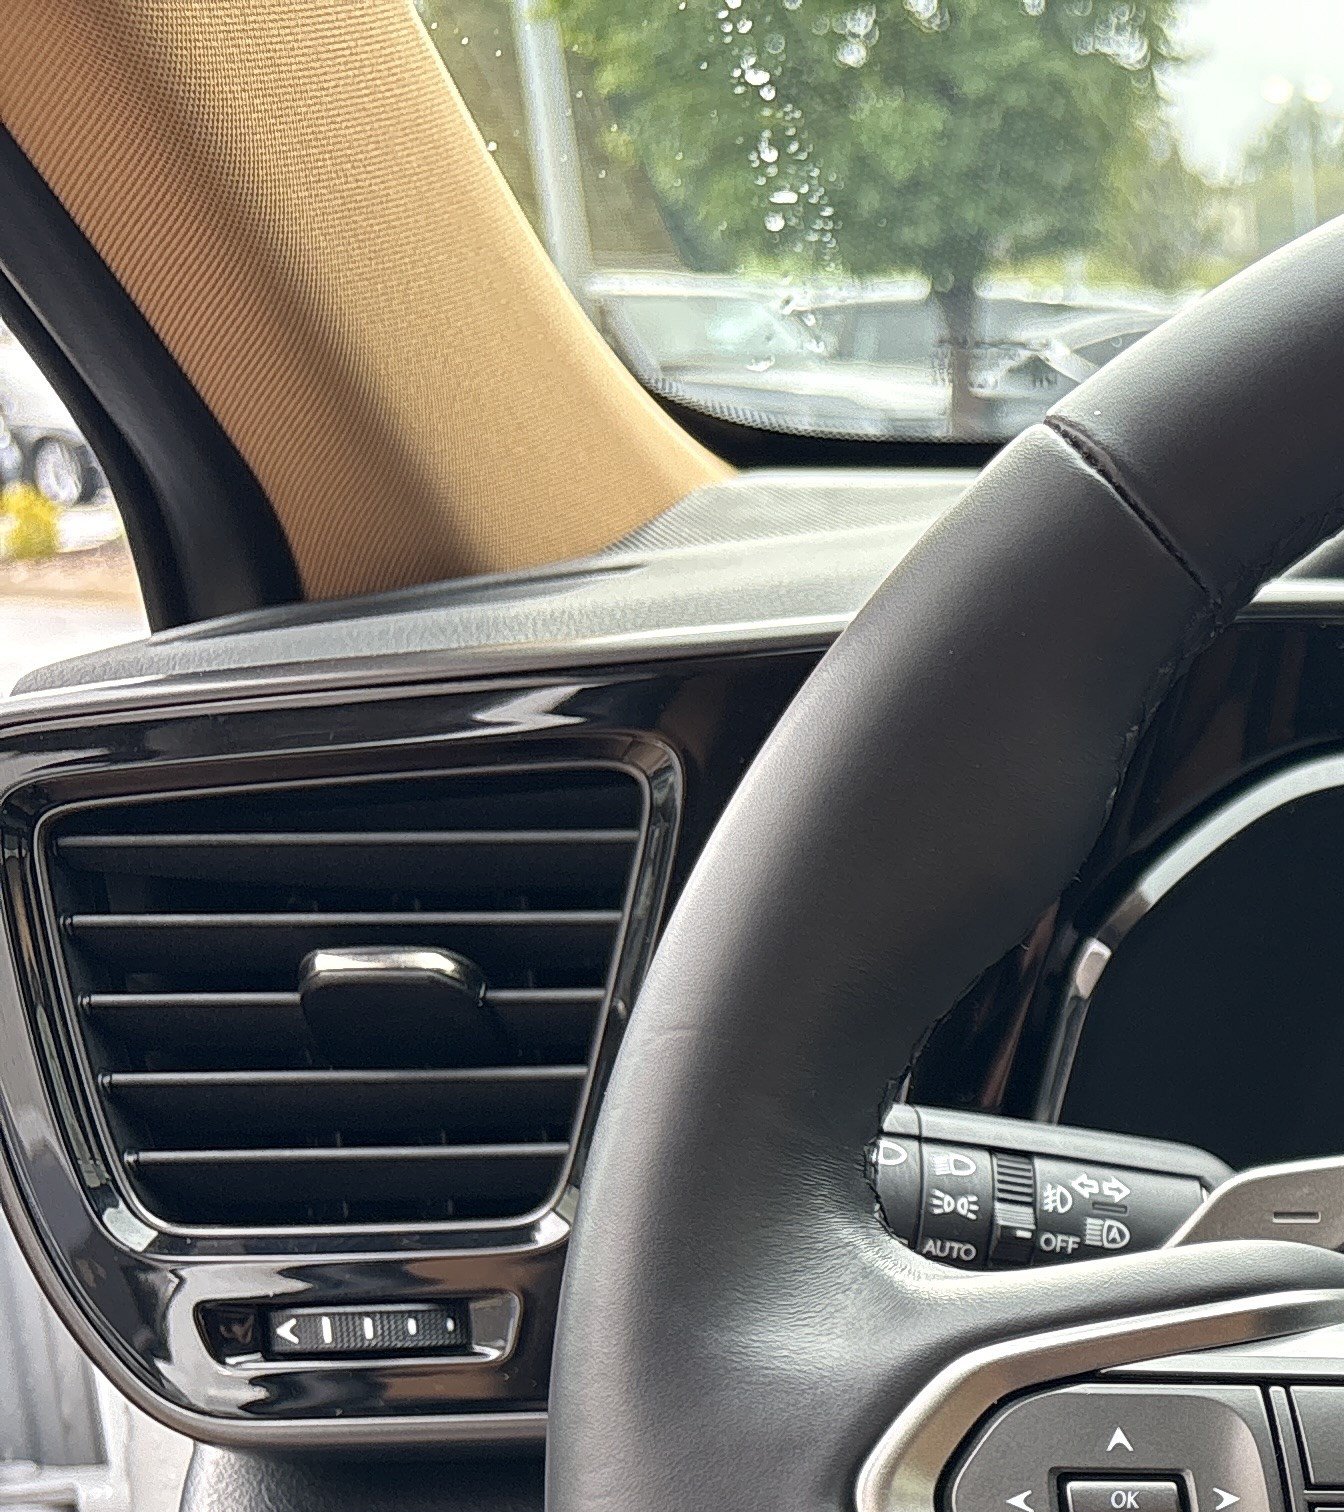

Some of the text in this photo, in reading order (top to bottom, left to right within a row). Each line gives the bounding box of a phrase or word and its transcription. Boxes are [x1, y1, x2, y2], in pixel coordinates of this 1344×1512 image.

[922, 1238, 977, 1262] AUTO
[1039, 1233, 1081, 1255] OFF
[1110, 1489, 1140, 1511] OK
